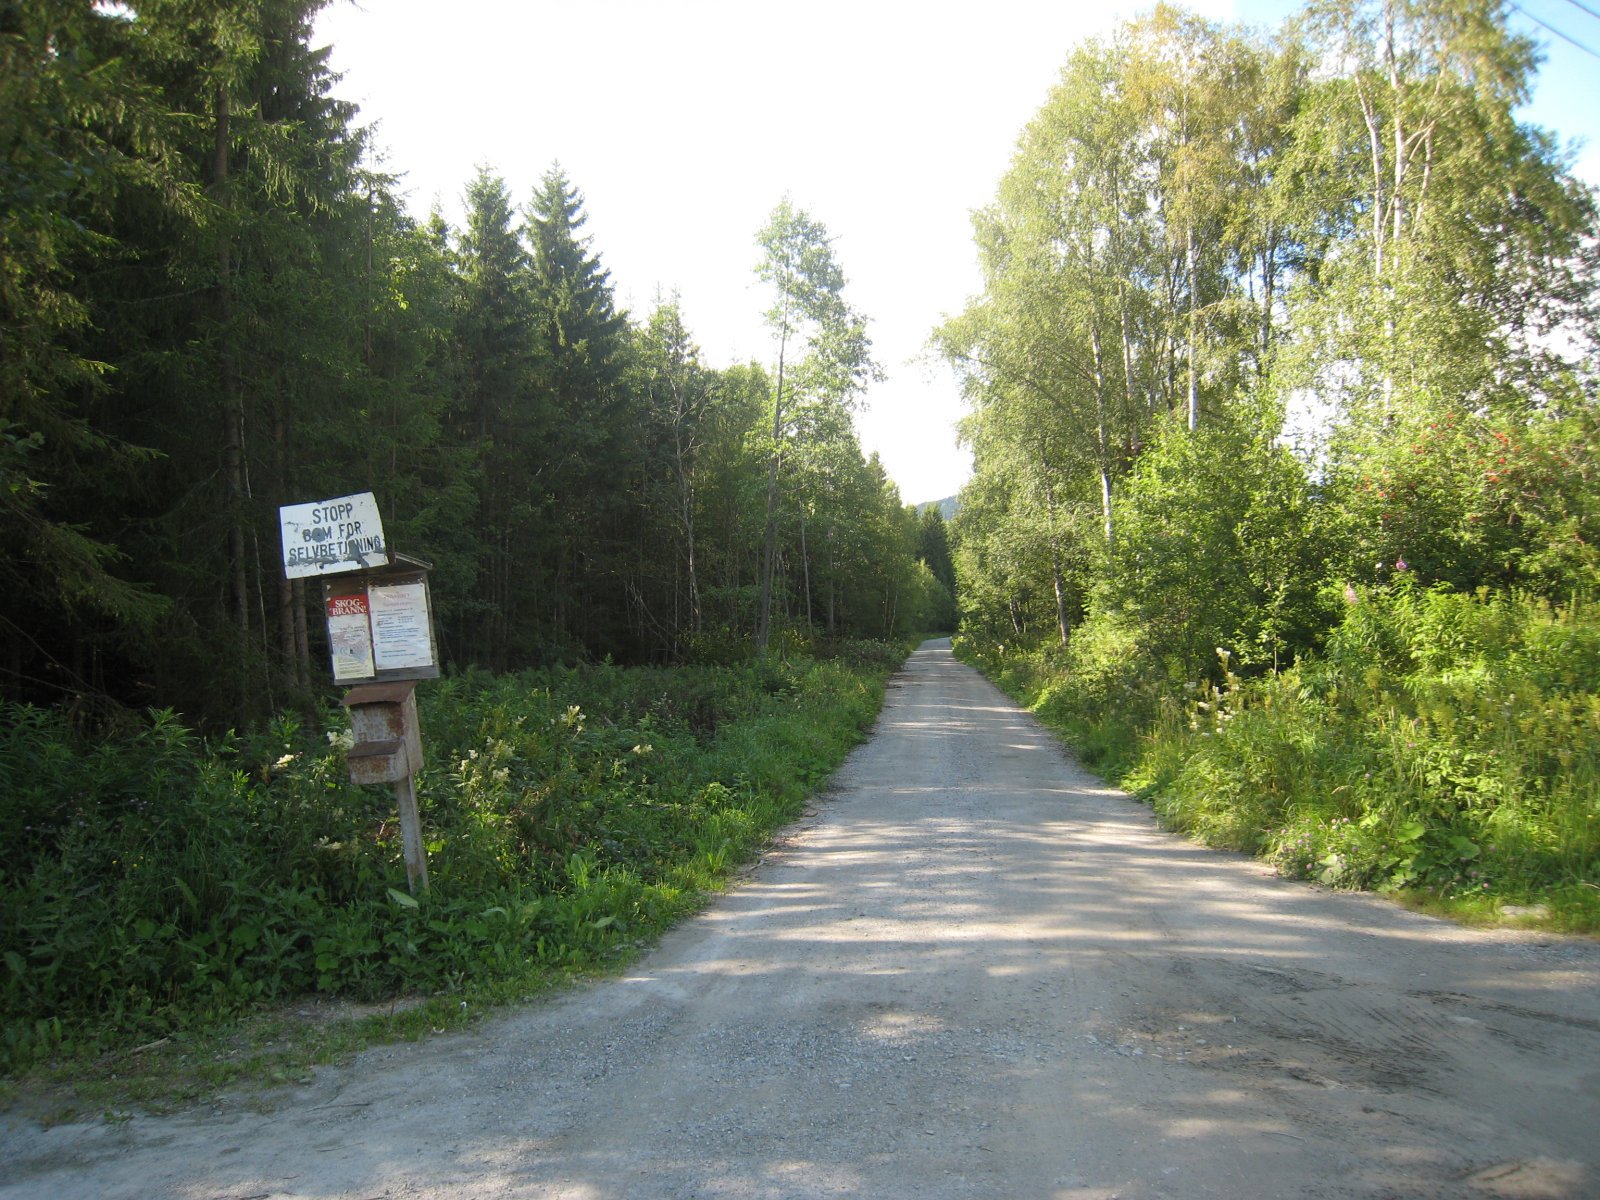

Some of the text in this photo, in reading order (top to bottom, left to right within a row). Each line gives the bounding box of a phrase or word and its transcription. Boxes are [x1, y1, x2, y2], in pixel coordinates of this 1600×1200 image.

[312, 502, 353, 525] STOPP
[302, 521, 362, 543] BM FOR
[289, 535, 381, 561] SELVBETJNING
[332, 605, 367, 616] BRANN!
[334, 598, 363, 608] SKOG-
